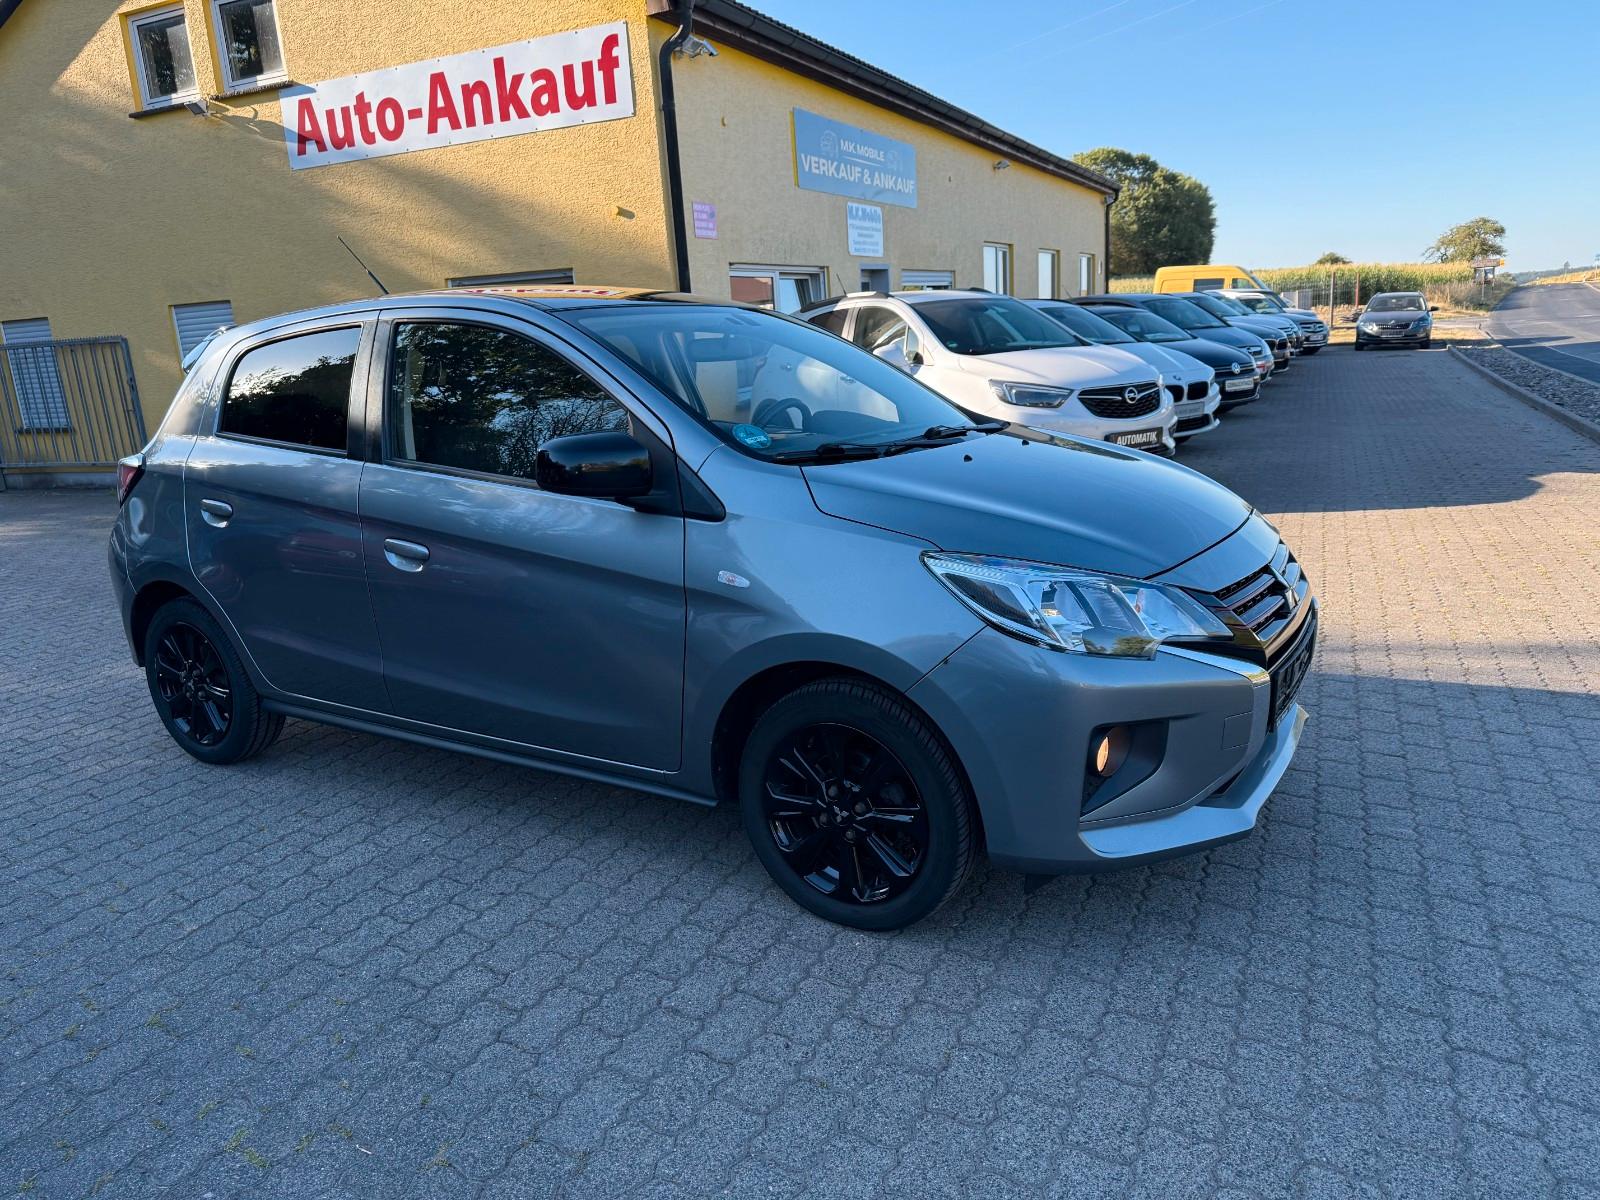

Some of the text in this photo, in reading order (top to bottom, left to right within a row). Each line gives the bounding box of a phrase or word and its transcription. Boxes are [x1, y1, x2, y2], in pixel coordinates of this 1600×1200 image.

[296, 33, 620, 157] Auto-Ankauf
[800, 153, 915, 194] VERKAUF & ANKAUF
[1117, 431, 1157, 446] AUTOMATIK
